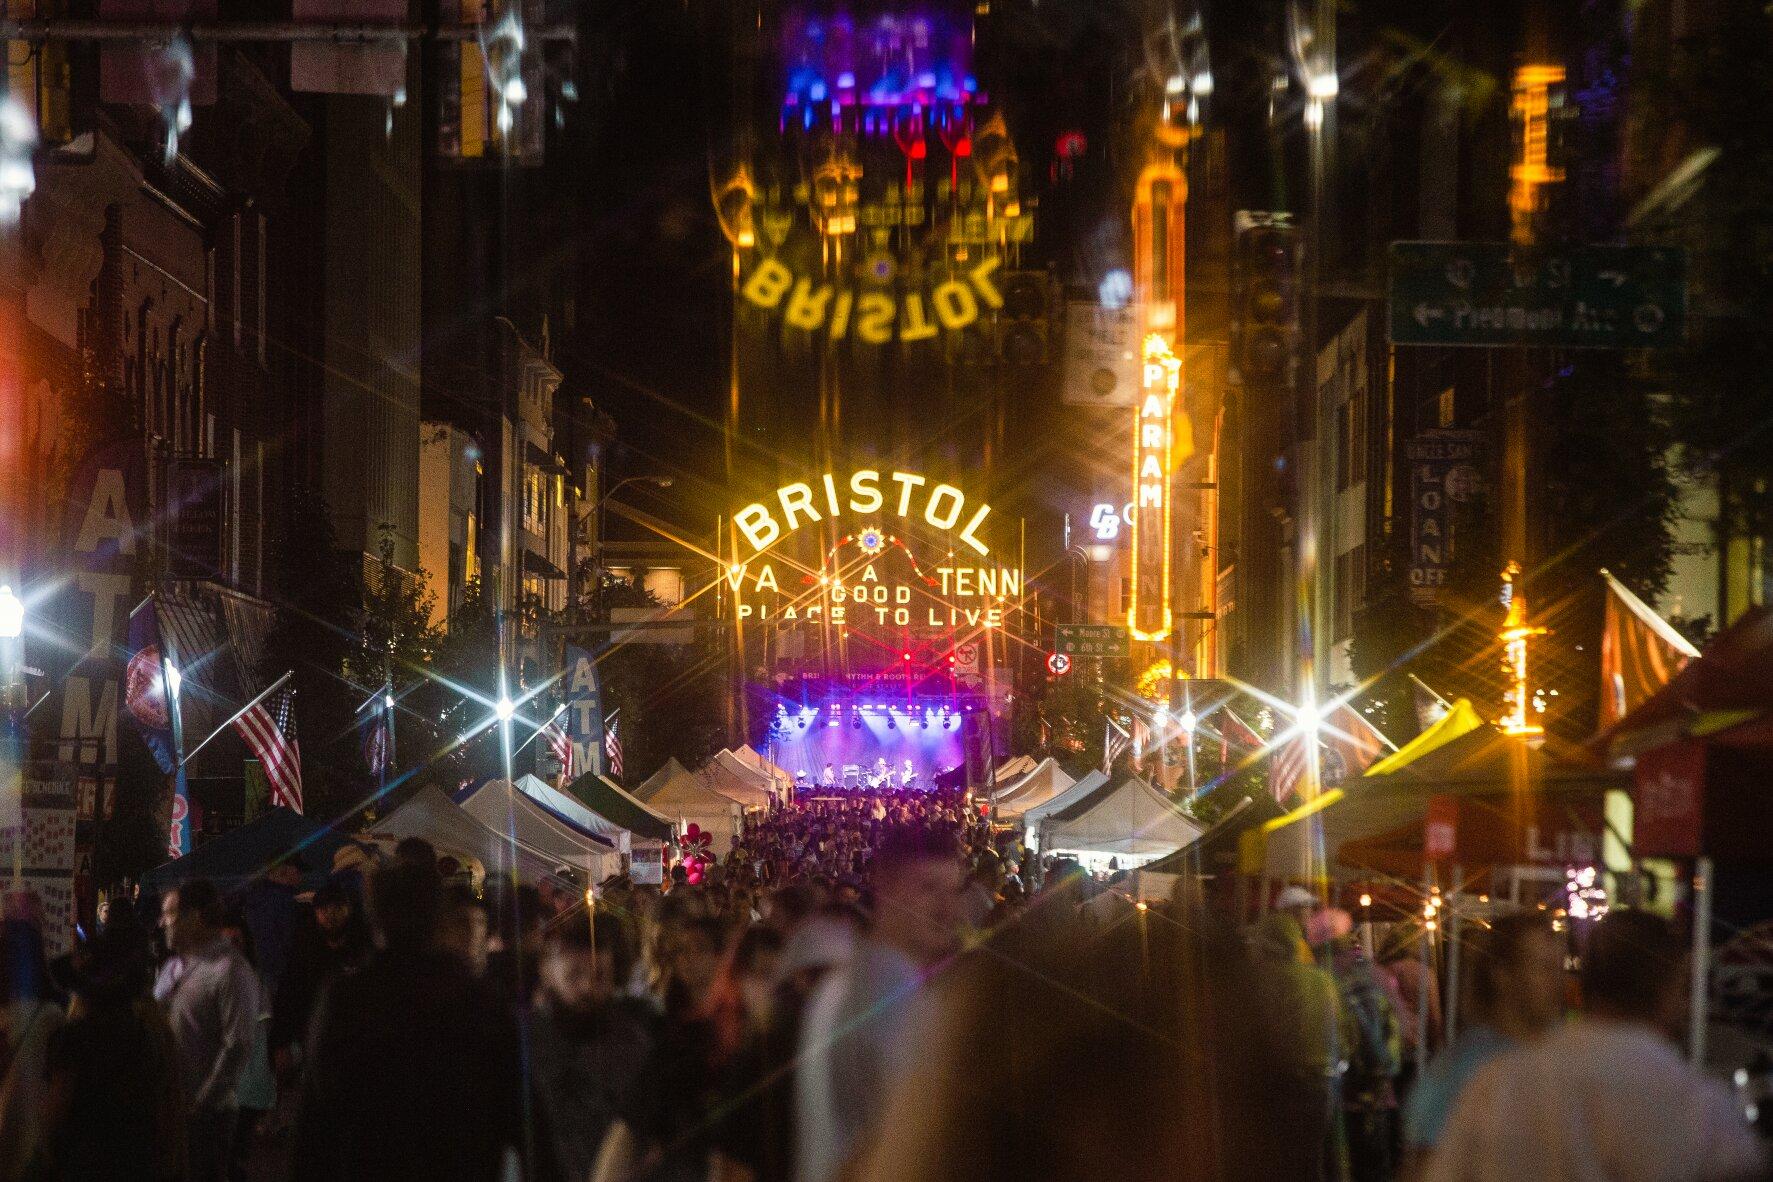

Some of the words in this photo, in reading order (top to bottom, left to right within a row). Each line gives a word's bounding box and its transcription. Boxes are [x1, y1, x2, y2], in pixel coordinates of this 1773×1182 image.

[733, 470, 991, 556] BRISTOL
[727, 565, 779, 592] VA
[937, 568, 1019, 596] TENN
[861, 564, 878, 582] A
[831, 585, 911, 603] GOOD
[58, 468, 137, 765] ATM
[874, 607, 909, 625] TO
[929, 608, 1002, 627] LIVE
[571, 657, 600, 777] ATM
